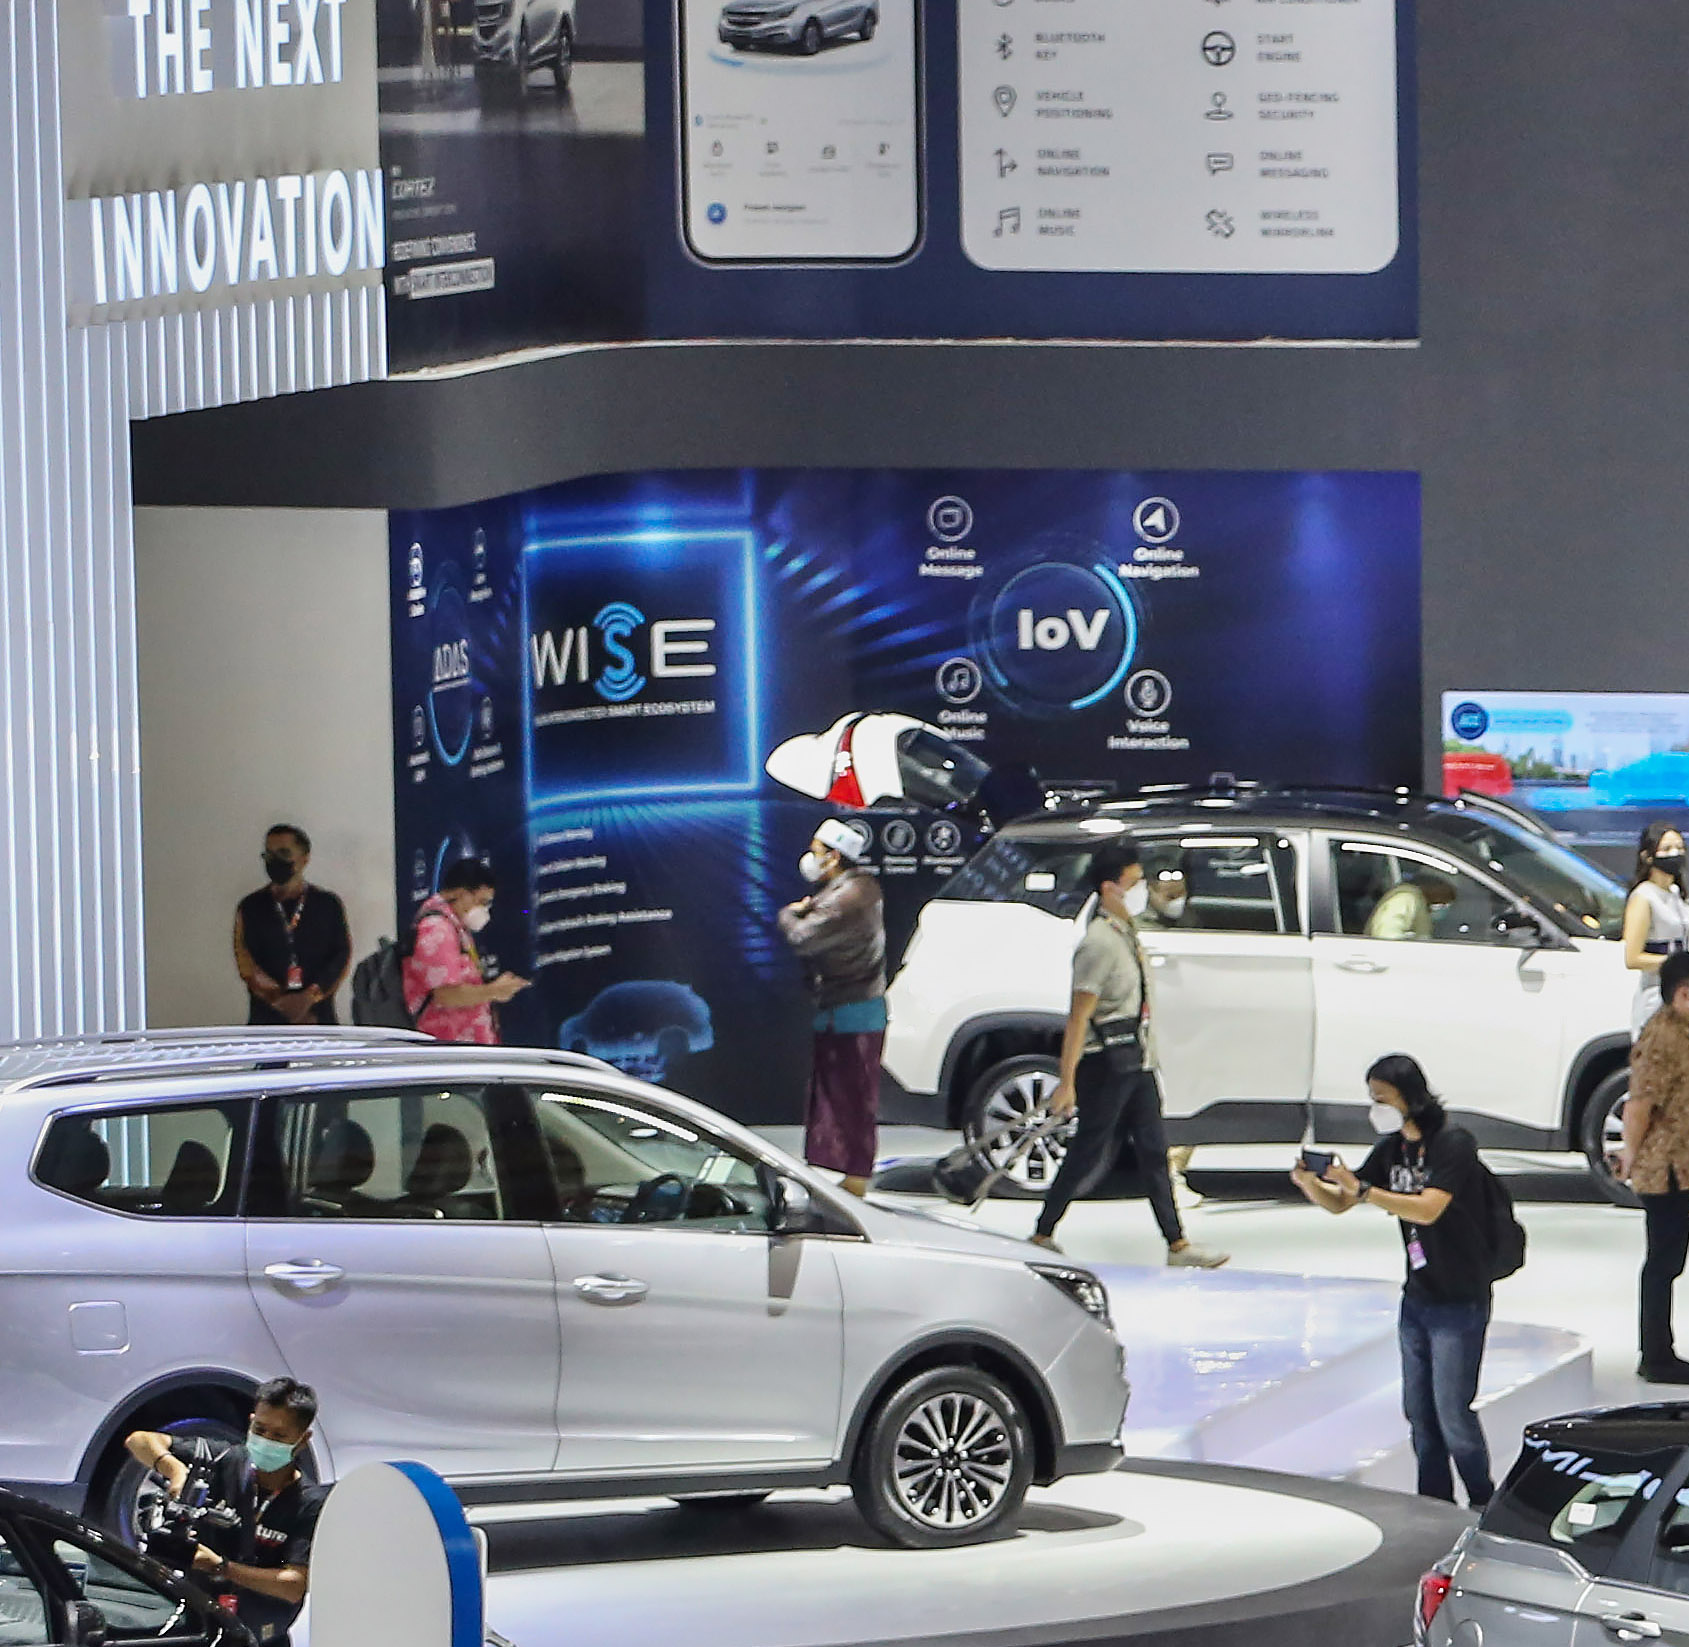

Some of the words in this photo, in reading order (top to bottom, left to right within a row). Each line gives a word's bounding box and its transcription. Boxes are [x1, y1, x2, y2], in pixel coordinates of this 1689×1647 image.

[128, 0, 213, 99] THE
[234, 0, 346, 89] NEXT
[90, 168, 387, 305] INNOVATION
[925, 546, 977, 562] Online
[1132, 546, 1185, 562] Online
[918, 563, 985, 580] Message
[1117, 563, 1201, 580] Navigation
[1017, 607, 1112, 651] IoV
[530, 612, 717, 692] WISE
[936, 709, 988, 724] Online
[1125, 718, 1171, 734] Voice
[1106, 735, 1191, 750] Interaction
